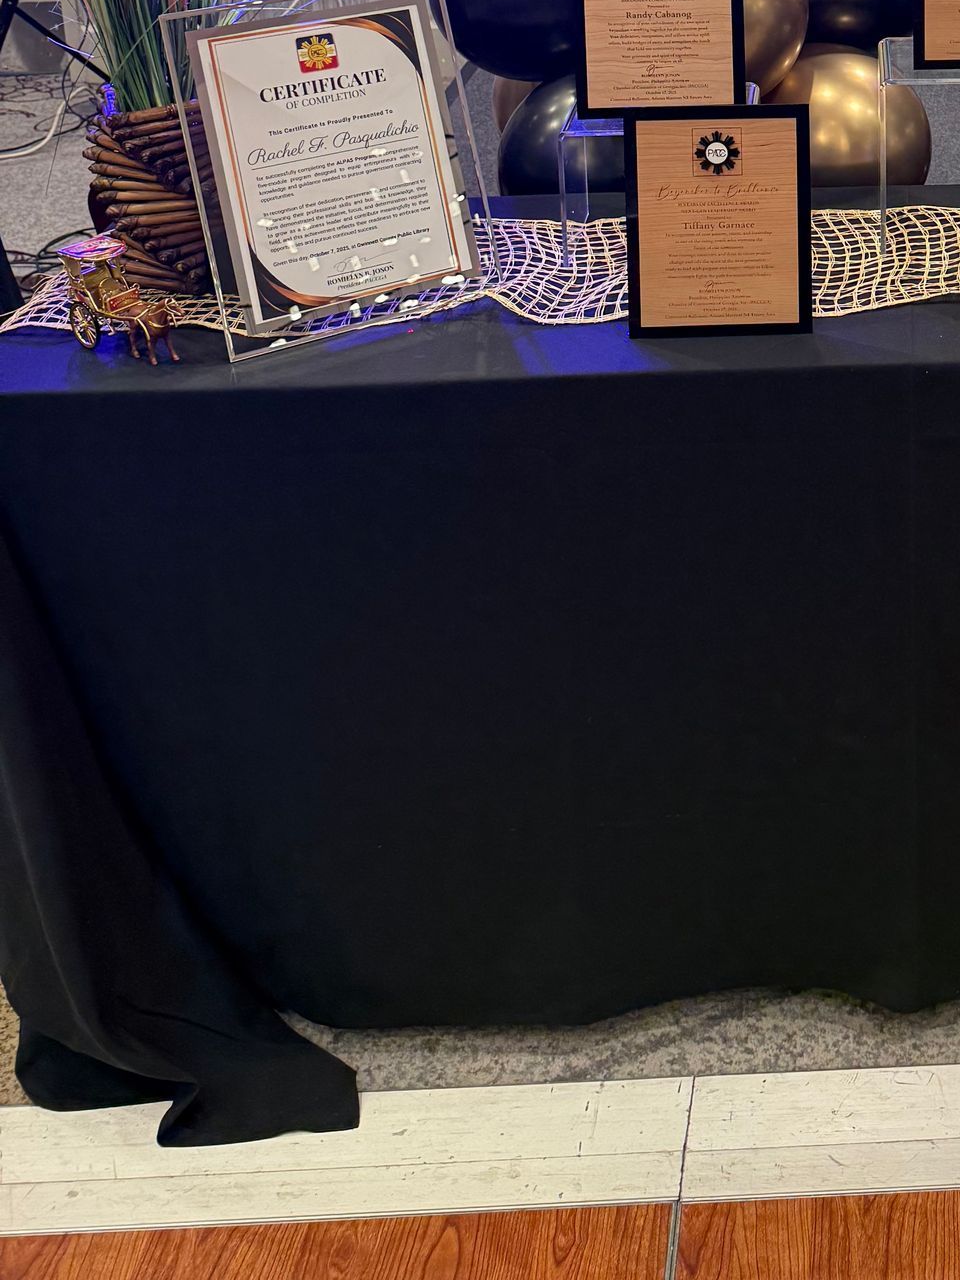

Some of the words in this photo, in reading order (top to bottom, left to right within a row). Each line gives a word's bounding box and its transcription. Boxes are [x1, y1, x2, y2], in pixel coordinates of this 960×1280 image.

[626, 11, 652, 19] Randy
[654, 10, 691, 19] Cabanog
[258, 66, 386, 104] CERTIFICATE
[285, 100, 299, 110] OF
[301, 88, 366, 107] COMPLETION
[268, 128, 282, 136] This
[283, 121, 318, 134] Certificate
[326, 115, 351, 126] Proudly
[352, 109, 383, 120] Presented
[245, 139, 307, 166] Rachel
[306, 134, 330, 153] F.
[331, 116, 421, 154] Pasqualichio
[264, 168, 296, 180] successfully
[297, 162, 325, 174] completing
[335, 156, 353, 165] ALPAS
[289, 173, 311, 183] program
[313, 168, 336, 178] designed
[297, 178, 321, 189] guidance
[321, 174, 340, 183] needed
[683, 221, 715, 231] Tiffany
[718, 221, 754, 229] Garnace
[273, 259, 288, 268] Given
[309, 249, 329, 259] October
[397, 230, 412, 238] Public
[412, 226, 430, 235] Library
[372, 264, 394, 275] JOSON
